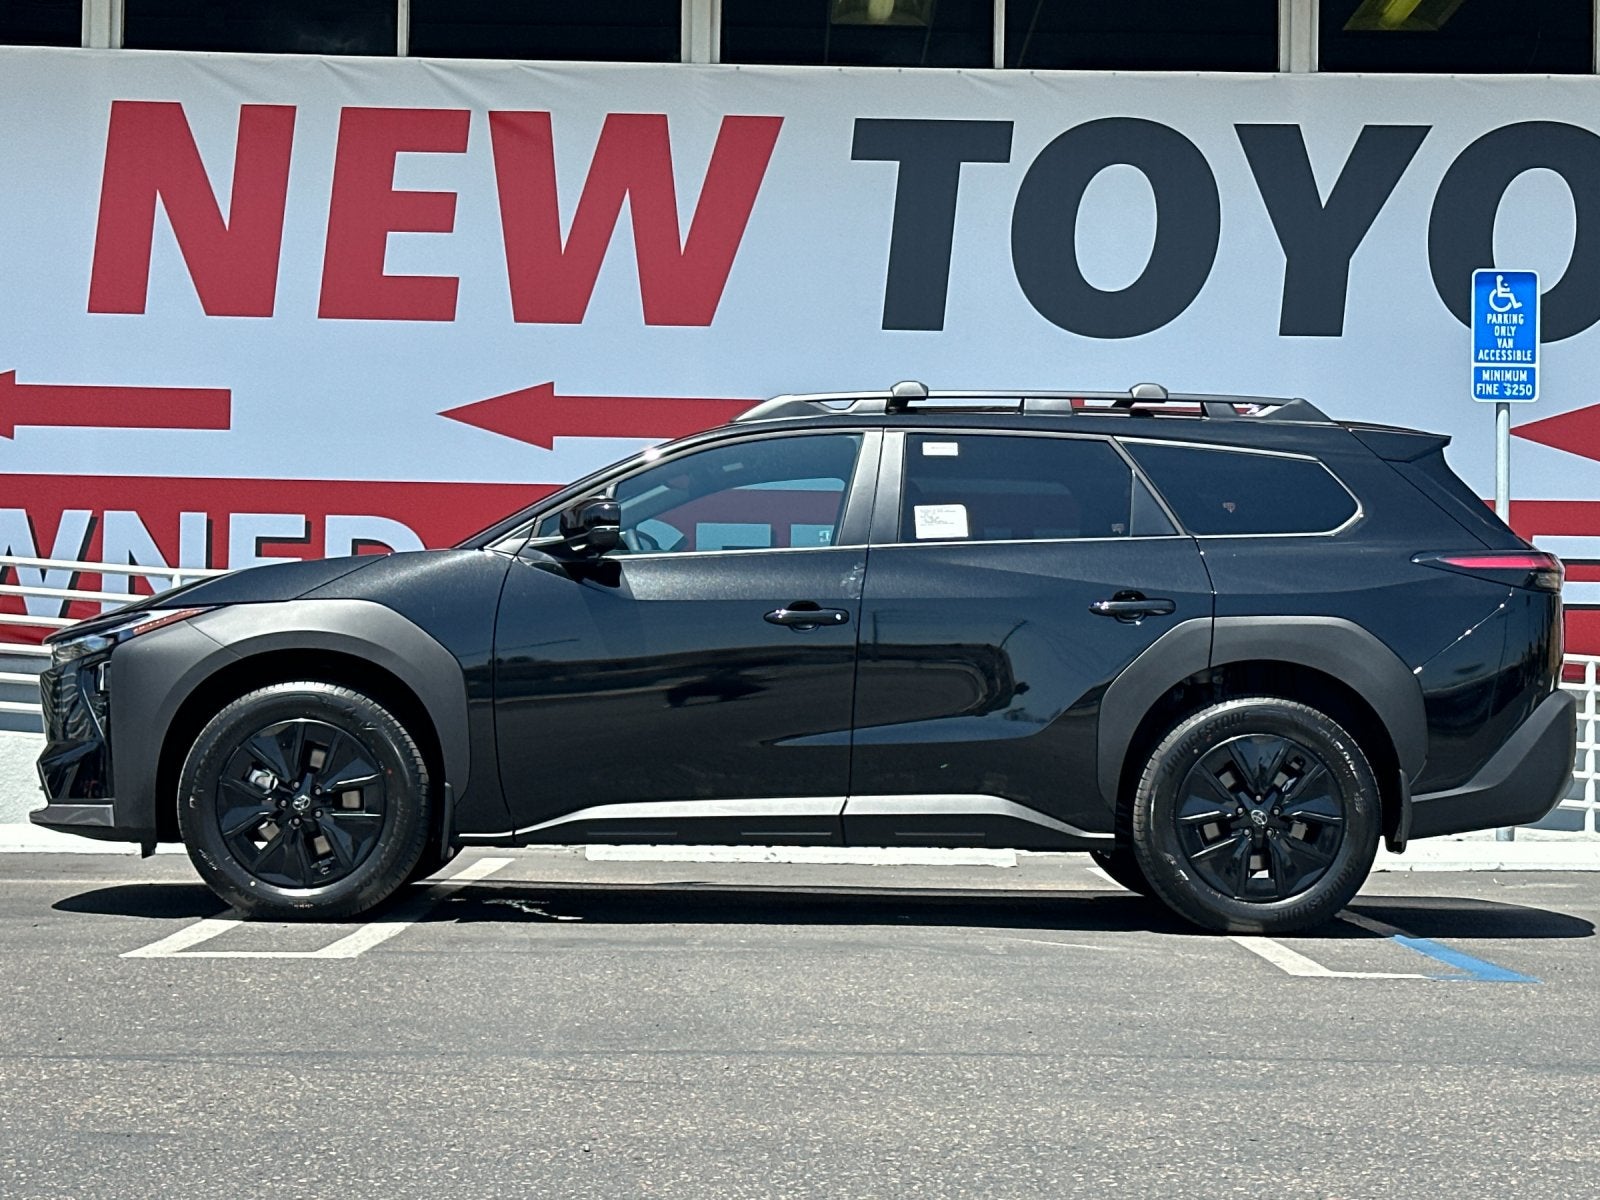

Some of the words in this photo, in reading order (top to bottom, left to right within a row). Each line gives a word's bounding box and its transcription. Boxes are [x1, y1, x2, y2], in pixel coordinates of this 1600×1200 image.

[88, 101, 785, 327] NEW
[850, 117, 1600, 343] TOYO
[1487, 313, 1524, 325] PARKING
[1494, 325, 1516, 336] ONLY
[1497, 338, 1513, 348] VAN
[1478, 349, 1532, 361] ACCESSIBLE
[1482, 370, 1527, 381] MINIMUM
[1476, 383, 1499, 395] FINE
[1503, 383, 1532, 395] $250
